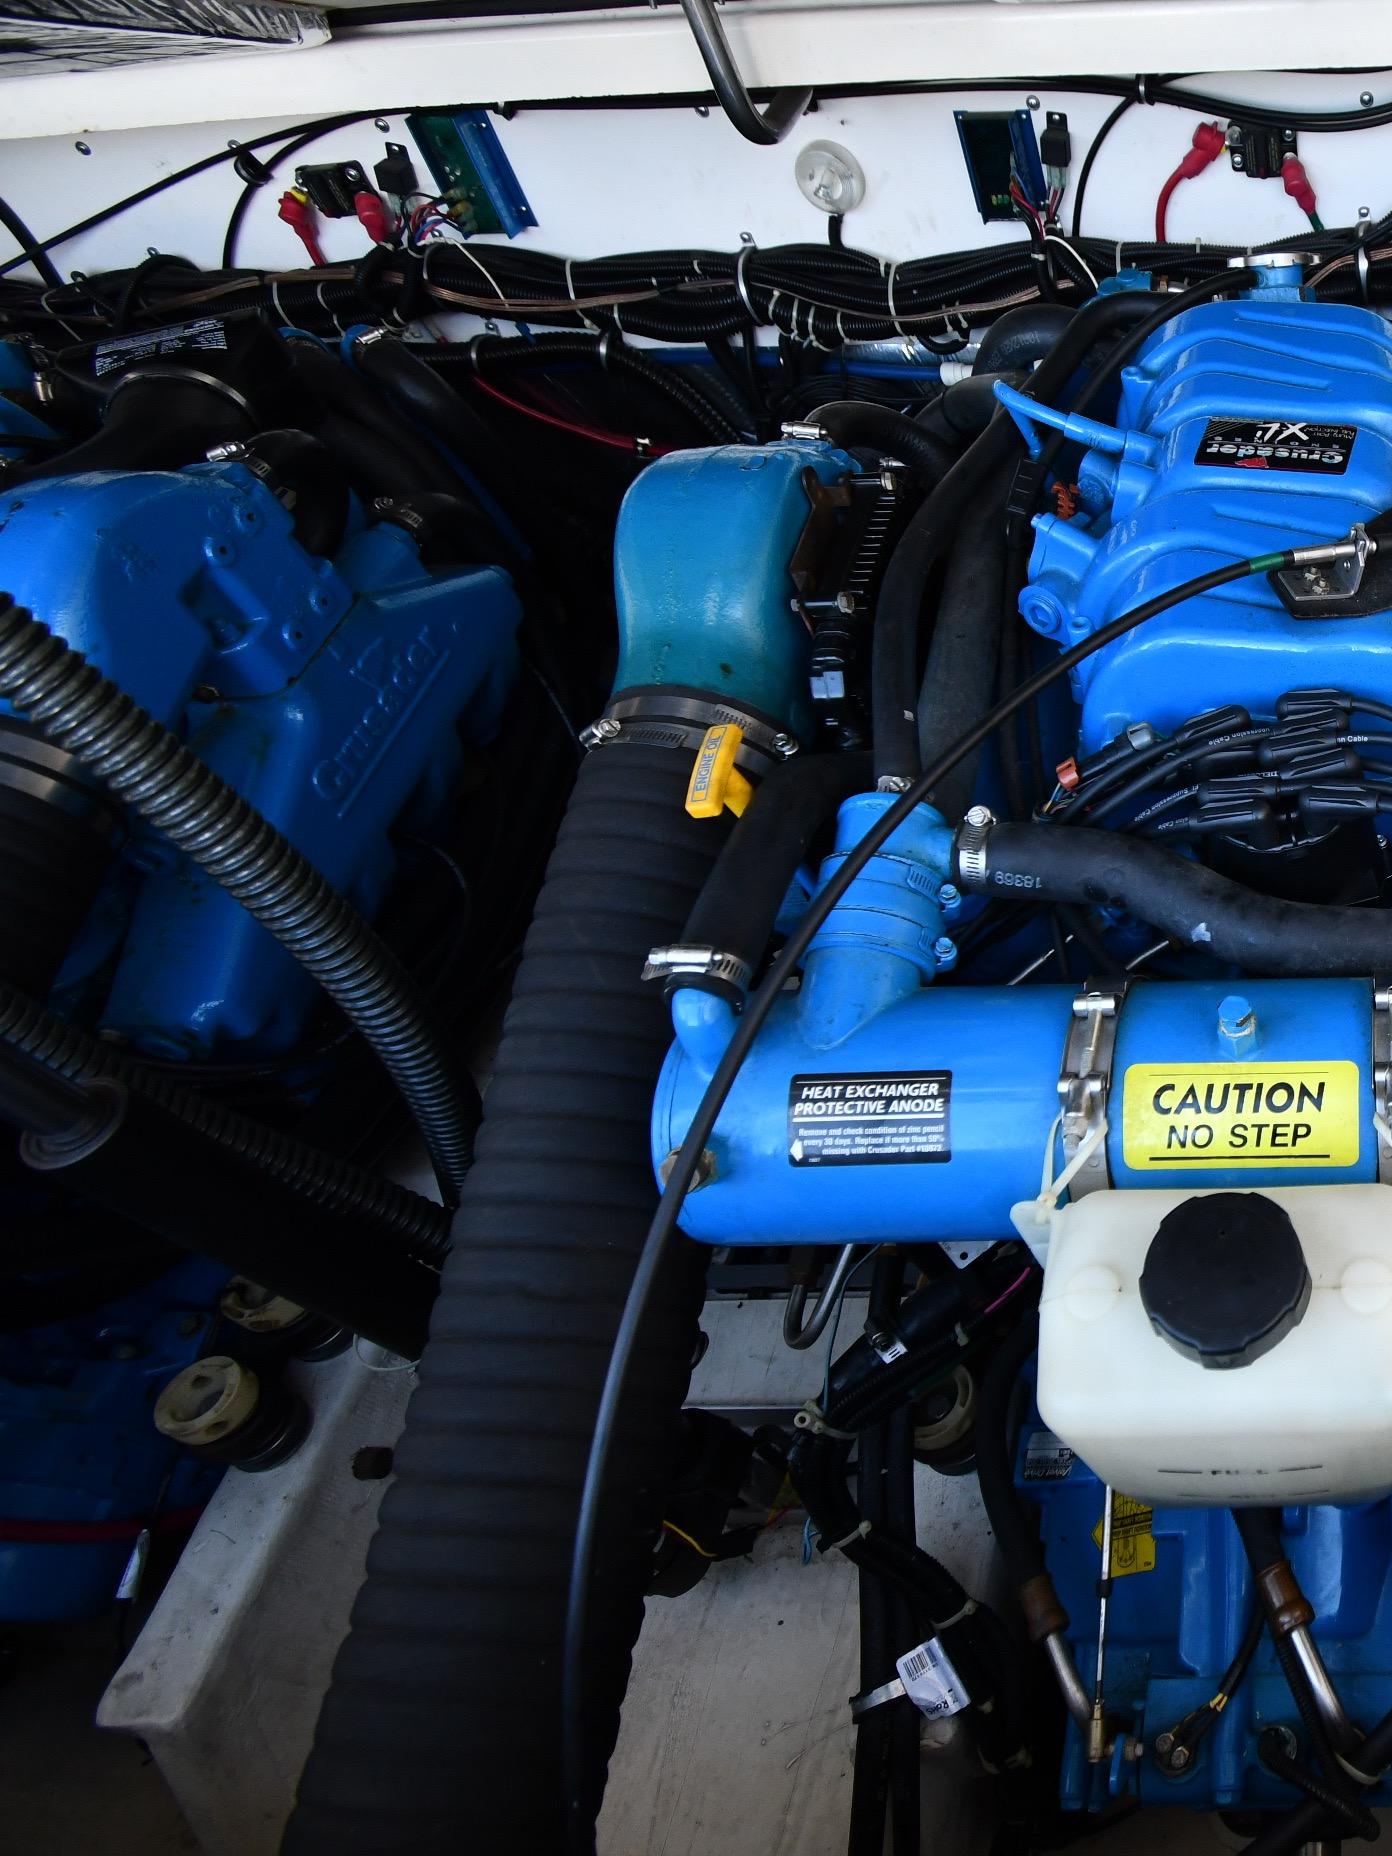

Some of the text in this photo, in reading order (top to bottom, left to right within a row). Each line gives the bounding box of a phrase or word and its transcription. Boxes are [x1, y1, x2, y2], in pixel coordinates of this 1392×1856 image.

[1206, 443, 1343, 464] Crusader
[1346, 734, 1369, 743] Cable
[695, 736, 720, 791] ENGINE OIL
[994, 870, 1043, 889] 18369
[801, 1083, 939, 1099] HEAT EXCHANGER
[1152, 1081, 1325, 1115] CAUTION
[794, 1099, 944, 1116] PROTECTIVE ANODE
[799, 1128, 827, 1136] Remove
[843, 1127, 863, 1135] check
[865, 1126, 896, 1134] condition
[907, 1125, 921, 1133] zinc
[1167, 1123, 1312, 1149] NO STEP
[868, 1146, 899, 1154] Crusader
[926, 1699, 949, 1715] RoHS
